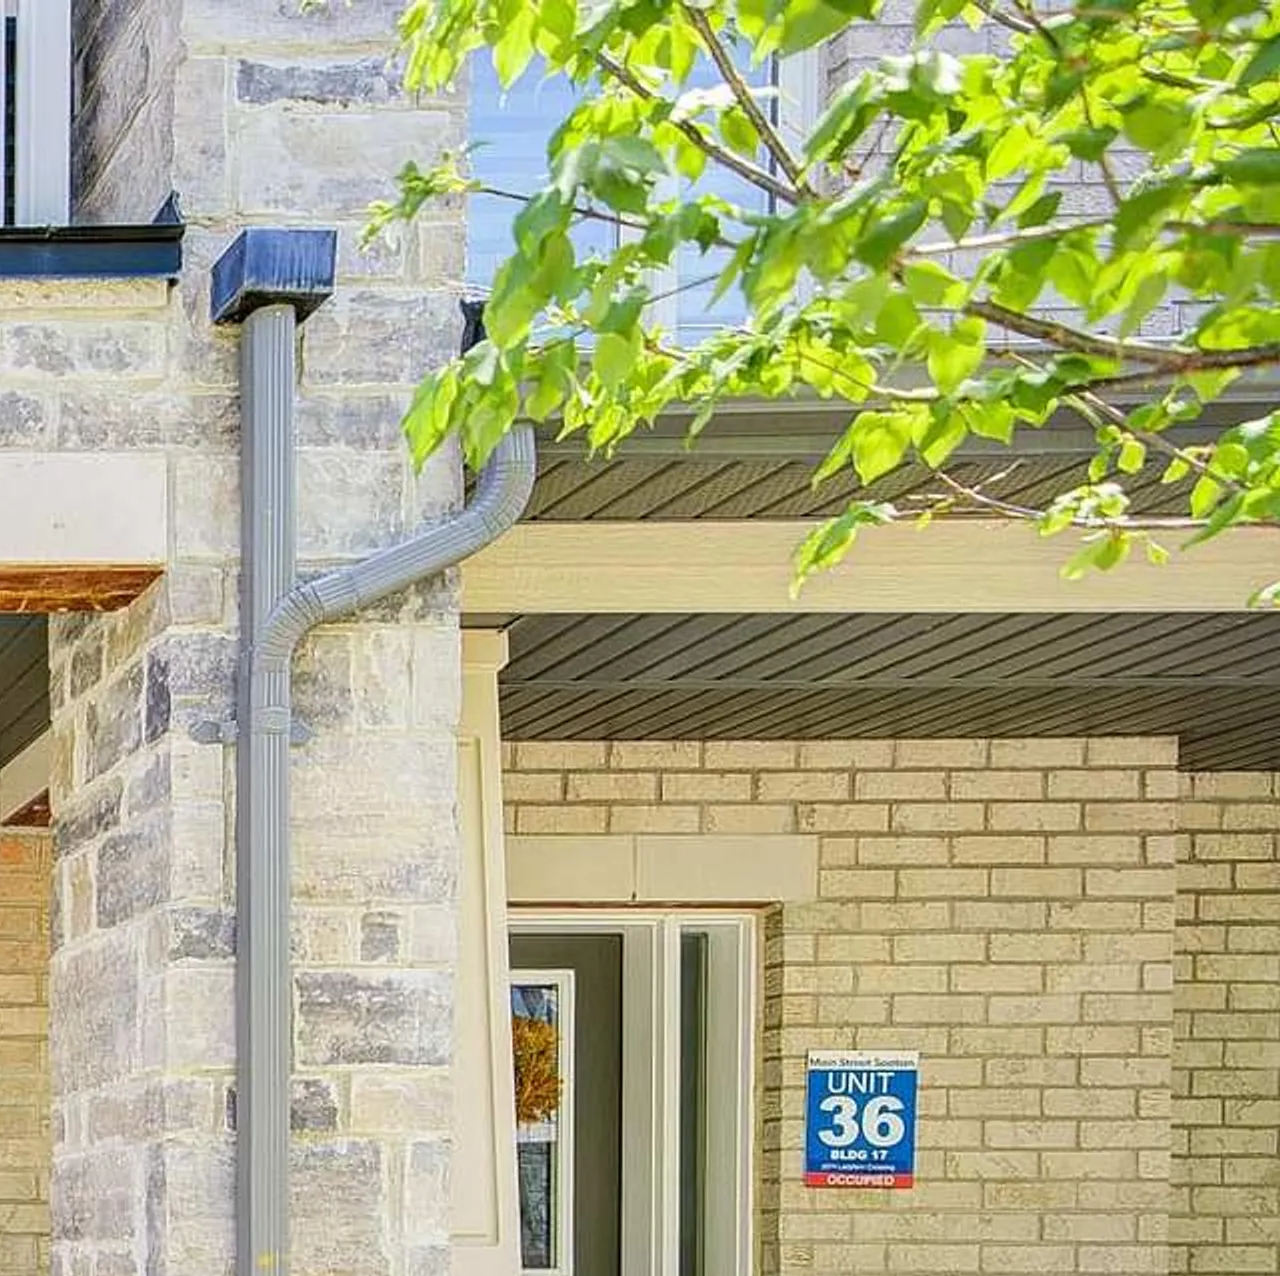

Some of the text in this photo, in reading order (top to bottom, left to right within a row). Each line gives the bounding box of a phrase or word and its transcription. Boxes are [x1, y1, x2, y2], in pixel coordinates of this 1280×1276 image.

[827, 1072, 895, 1094] UNIT
[818, 1095, 905, 1147] 36
[830, 1150, 888, 1160] BLDG 17
[827, 1174, 895, 1186] OCCUPIED
